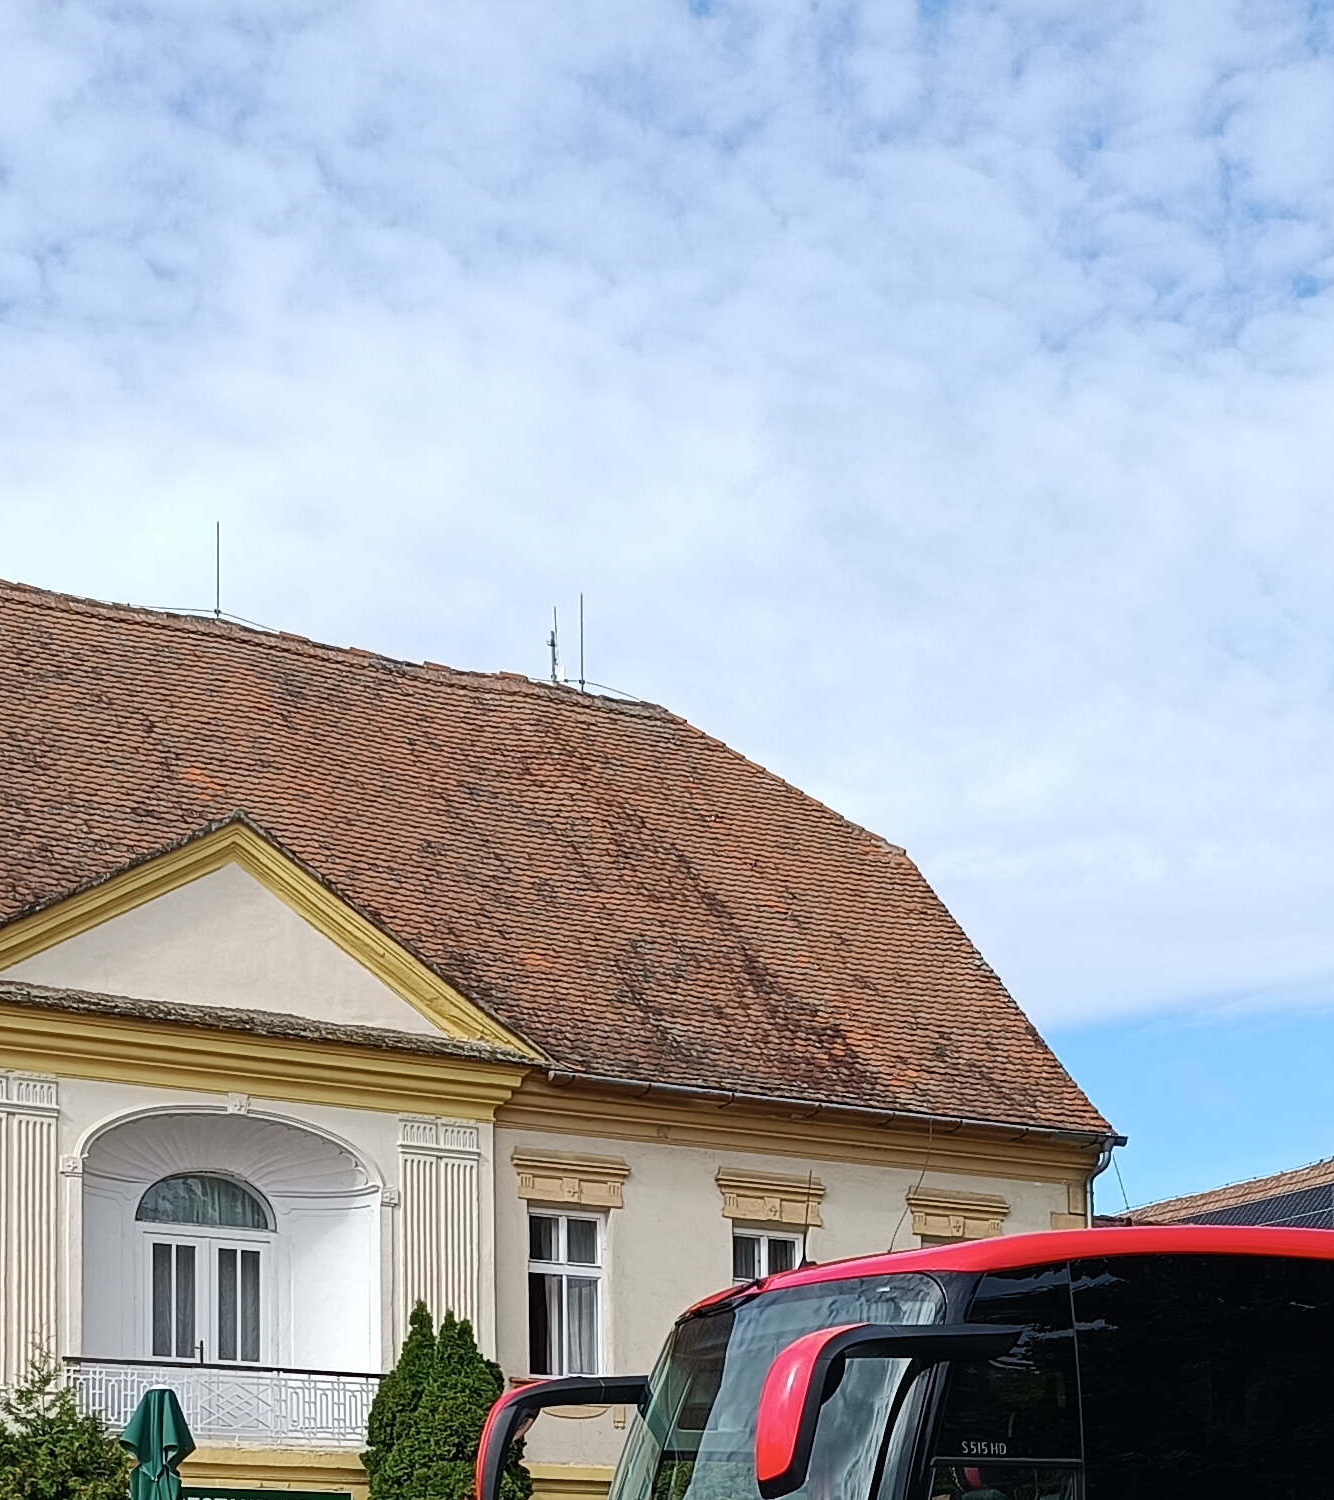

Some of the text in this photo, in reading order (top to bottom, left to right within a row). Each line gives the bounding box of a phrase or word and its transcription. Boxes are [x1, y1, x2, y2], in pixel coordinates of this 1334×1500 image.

[961, 1440, 1007, 1455] S 515 HD
